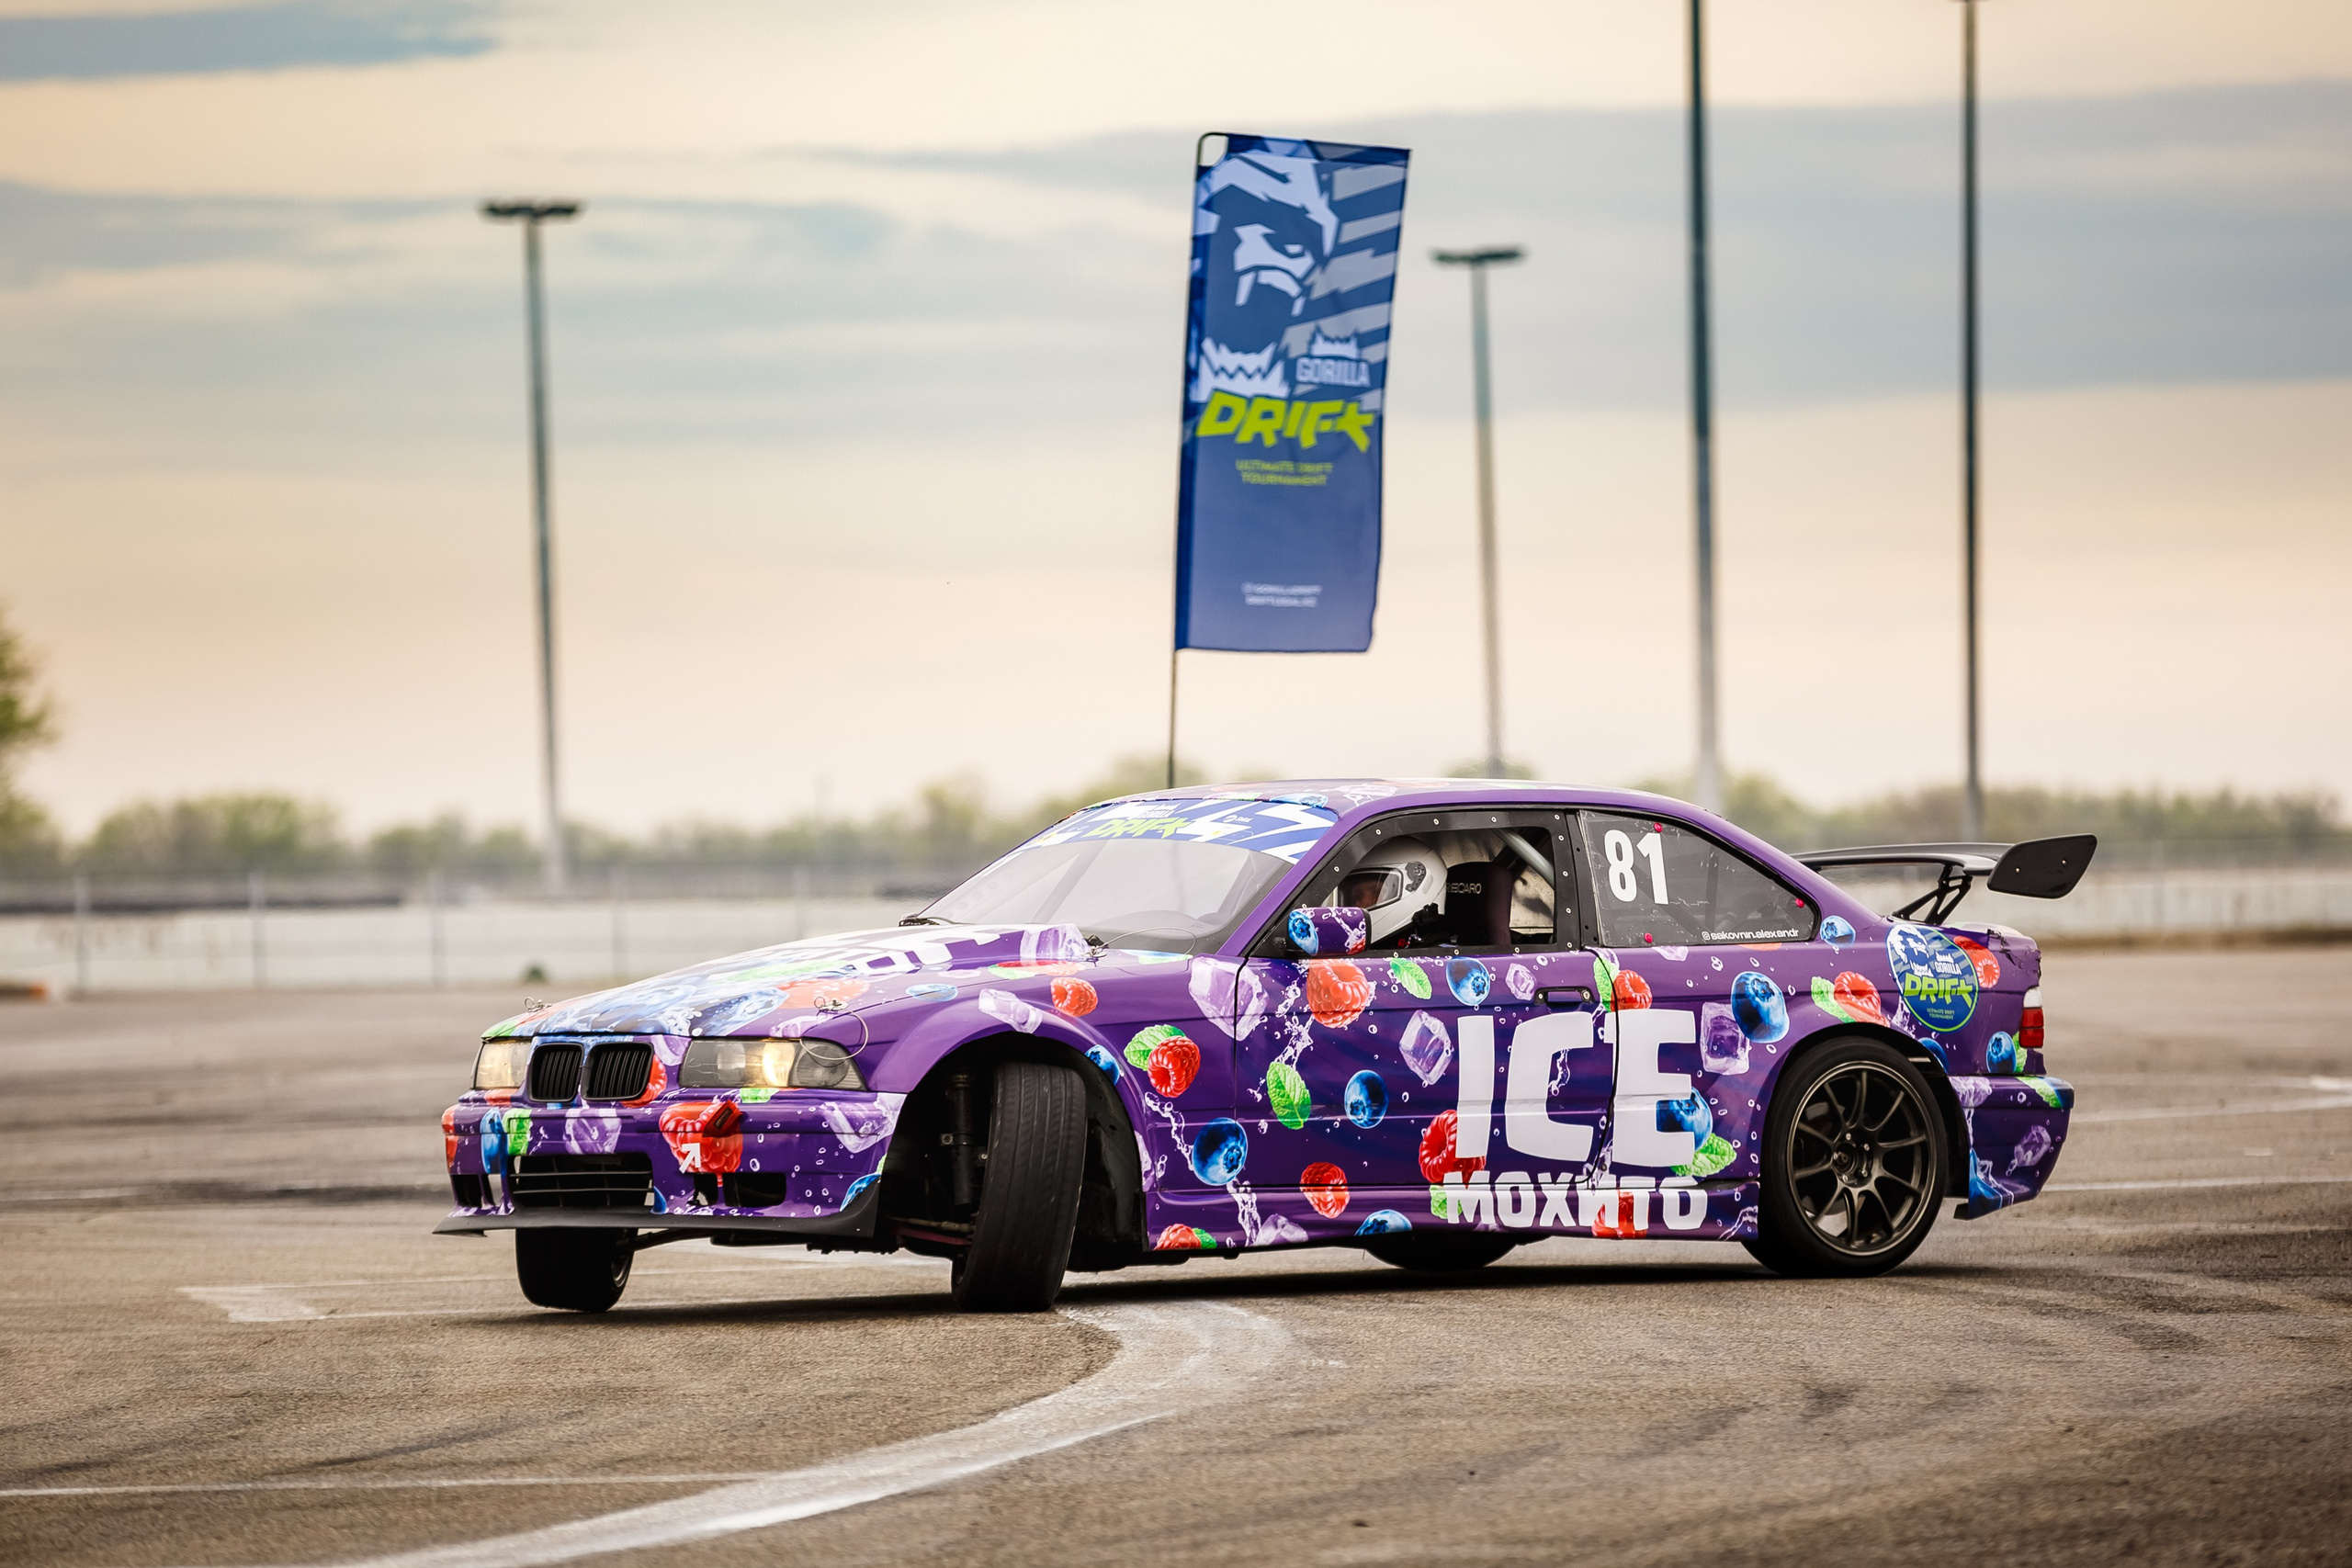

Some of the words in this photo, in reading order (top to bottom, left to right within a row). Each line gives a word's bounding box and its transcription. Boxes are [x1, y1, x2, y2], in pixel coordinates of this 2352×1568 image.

[1296, 356, 1370, 388] GORILLA
[1196, 390, 1374, 453] DRIFT
[1080, 817, 1193, 839] DRIFT
[1604, 829, 1669, 905] 81
[1446, 882, 1482, 894] RECARO
[1934, 961, 1962, 975] GORILLA
[1904, 972, 1973, 1009] DRIFT
[1455, 1009, 1696, 1168] ICE
[1443, 1170, 1708, 1231] МОХИТО
